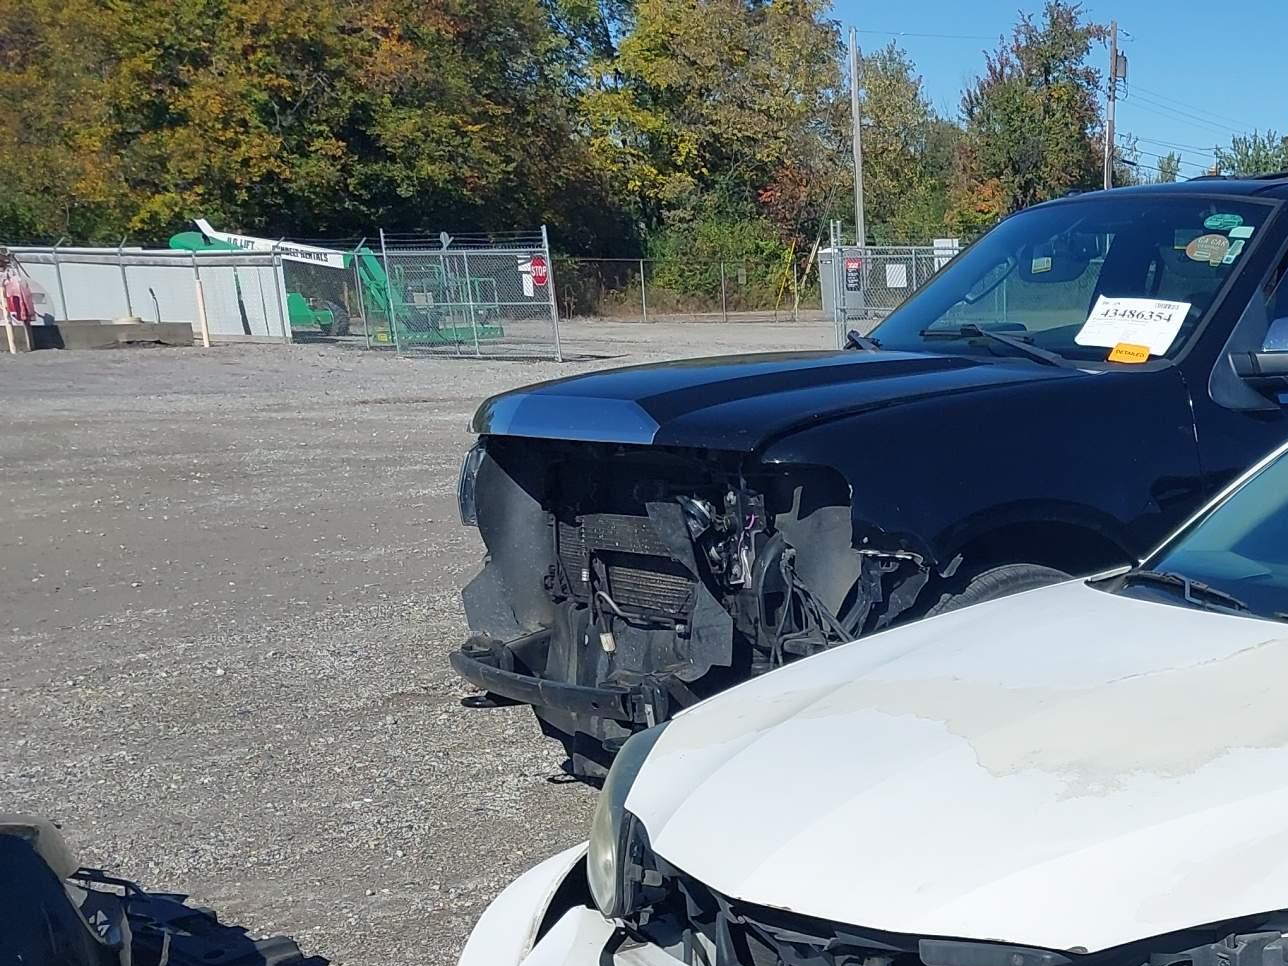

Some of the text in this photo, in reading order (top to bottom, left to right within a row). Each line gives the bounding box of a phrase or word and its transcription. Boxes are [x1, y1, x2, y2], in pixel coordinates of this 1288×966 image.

[531, 266, 547, 277] STOP
[1100, 308, 1173, 323] 43486354
[1115, 349, 1146, 358] DETAILED
